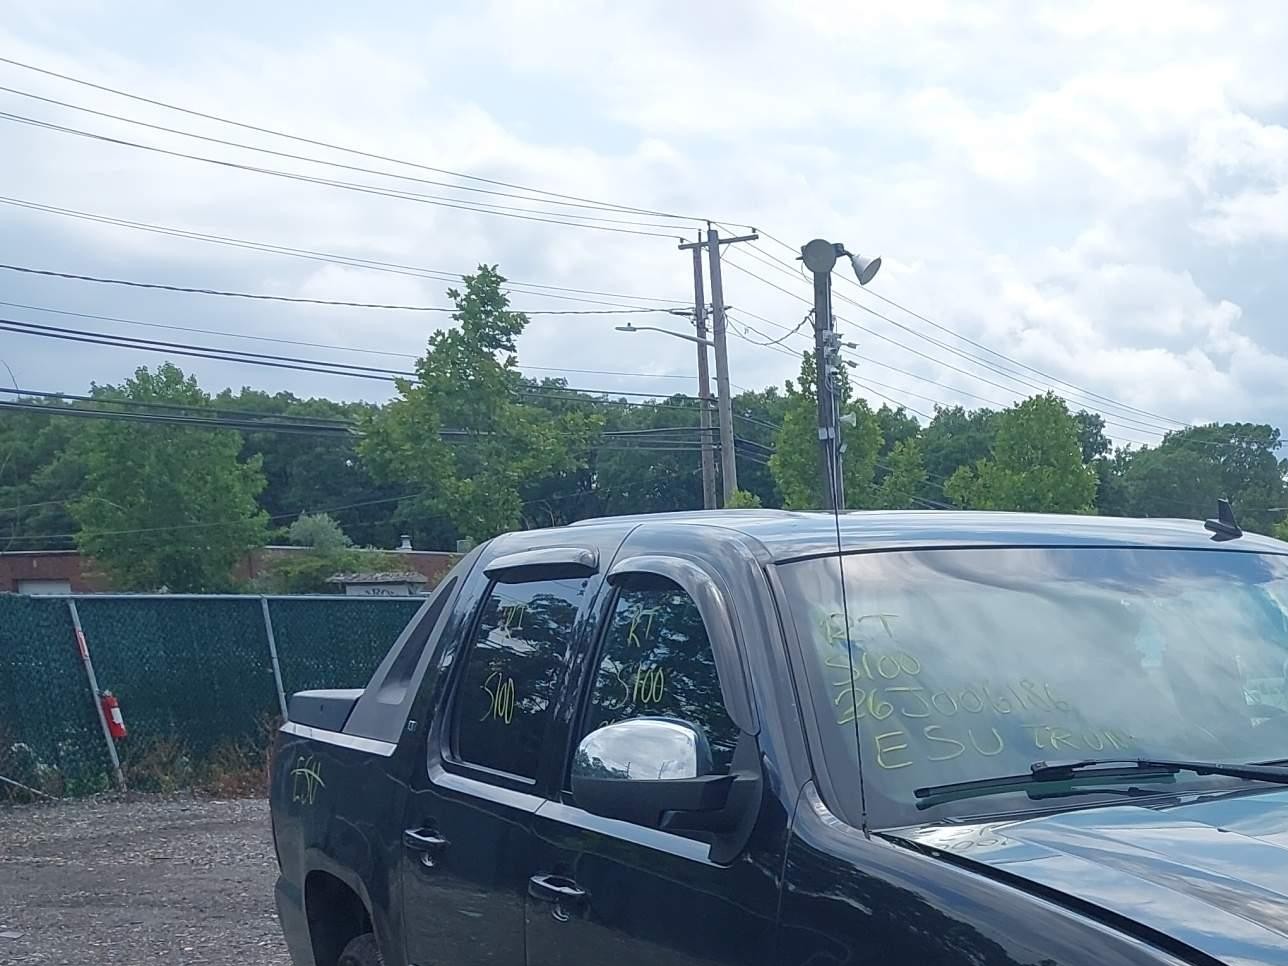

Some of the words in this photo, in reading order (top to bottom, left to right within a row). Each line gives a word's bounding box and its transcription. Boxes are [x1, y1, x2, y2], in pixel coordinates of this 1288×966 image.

[628, 605, 661, 647] RT
[822, 612, 899, 645] RT
[874, 725, 1005, 770] ESU
